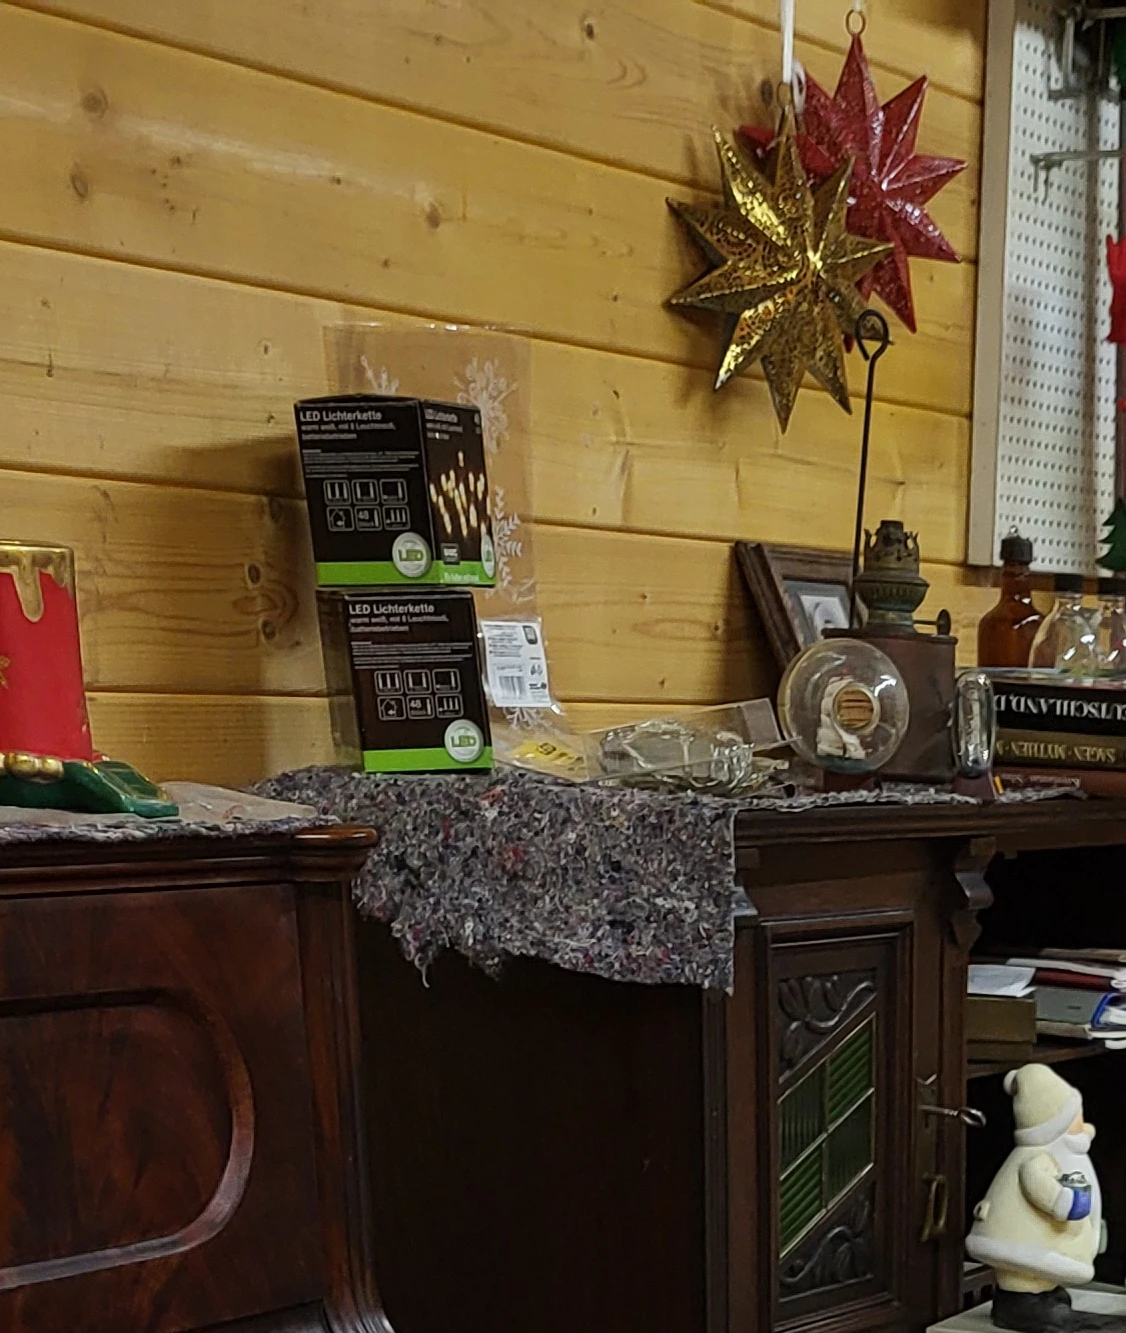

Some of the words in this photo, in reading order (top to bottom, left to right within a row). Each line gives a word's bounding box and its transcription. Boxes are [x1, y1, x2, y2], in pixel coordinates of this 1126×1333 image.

[299, 410, 321, 422] LED
[322, 409, 383, 422] Lichterkette
[398, 548, 424, 562] LED
[349, 604, 371, 615] LED
[372, 602, 435, 614] Lichterkette
[409, 700, 422, 709] 48
[450, 735, 478, 748] LED
[1011, 740, 1068, 761] MYTHEN
[1073, 745, 1117, 764] SAGEN
